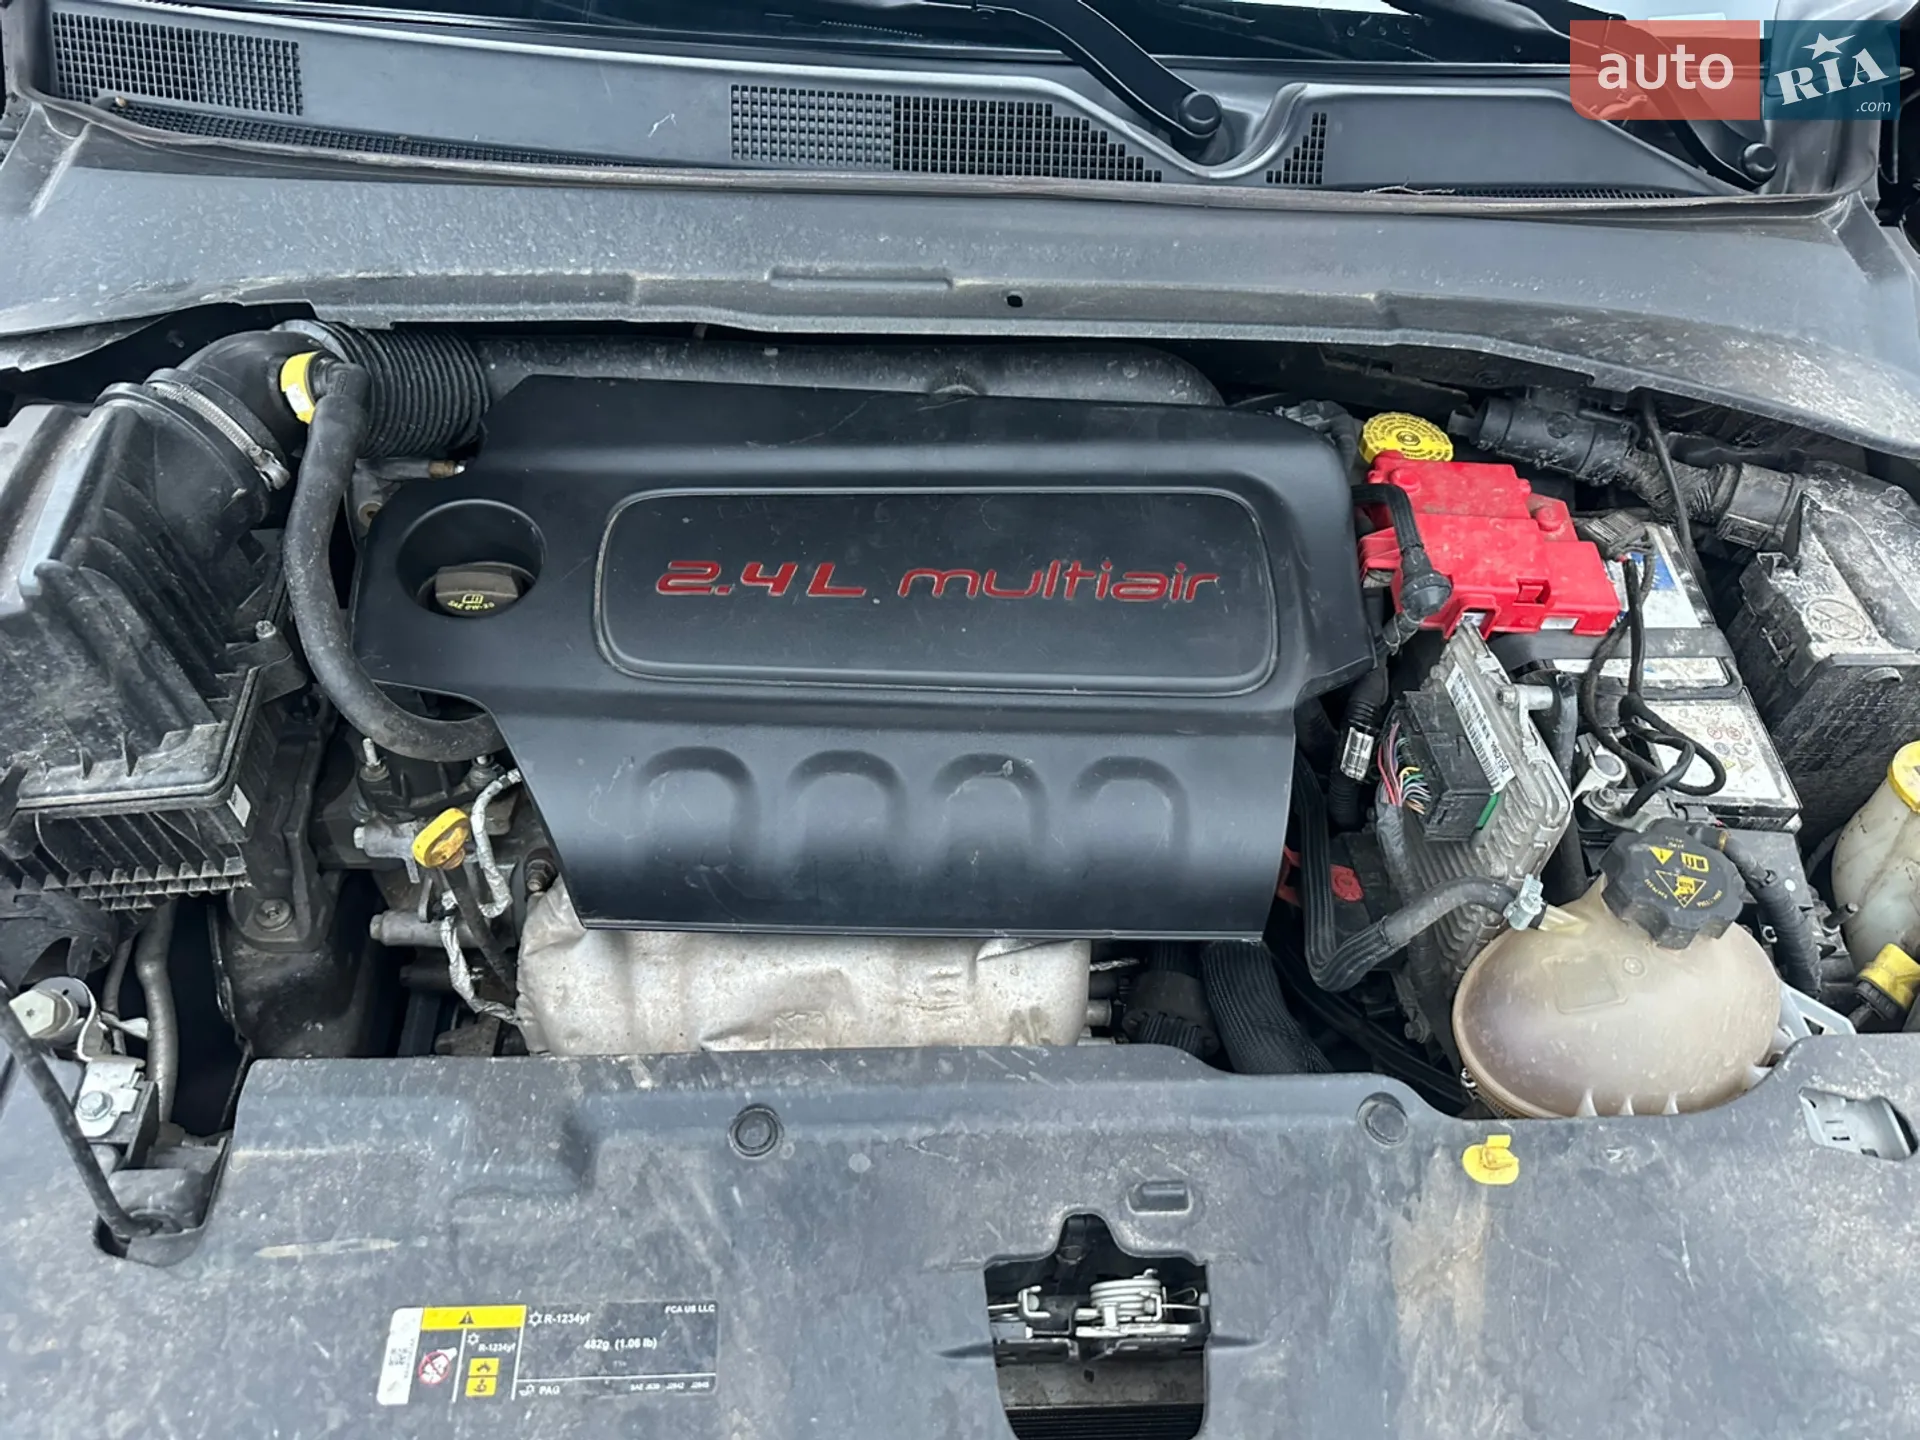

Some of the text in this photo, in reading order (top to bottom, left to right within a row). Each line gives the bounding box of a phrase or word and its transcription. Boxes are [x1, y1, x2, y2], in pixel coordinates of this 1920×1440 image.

[898, 559, 1220, 602] multiair
[664, 1304, 716, 1314] FCA US LLC
[543, 1312, 591, 1325] R-1234yf
[478, 1343, 516, 1353] R-1234yf
[642, 1337, 658, 1350] lb)
[538, 1385, 560, 1396] PAG
